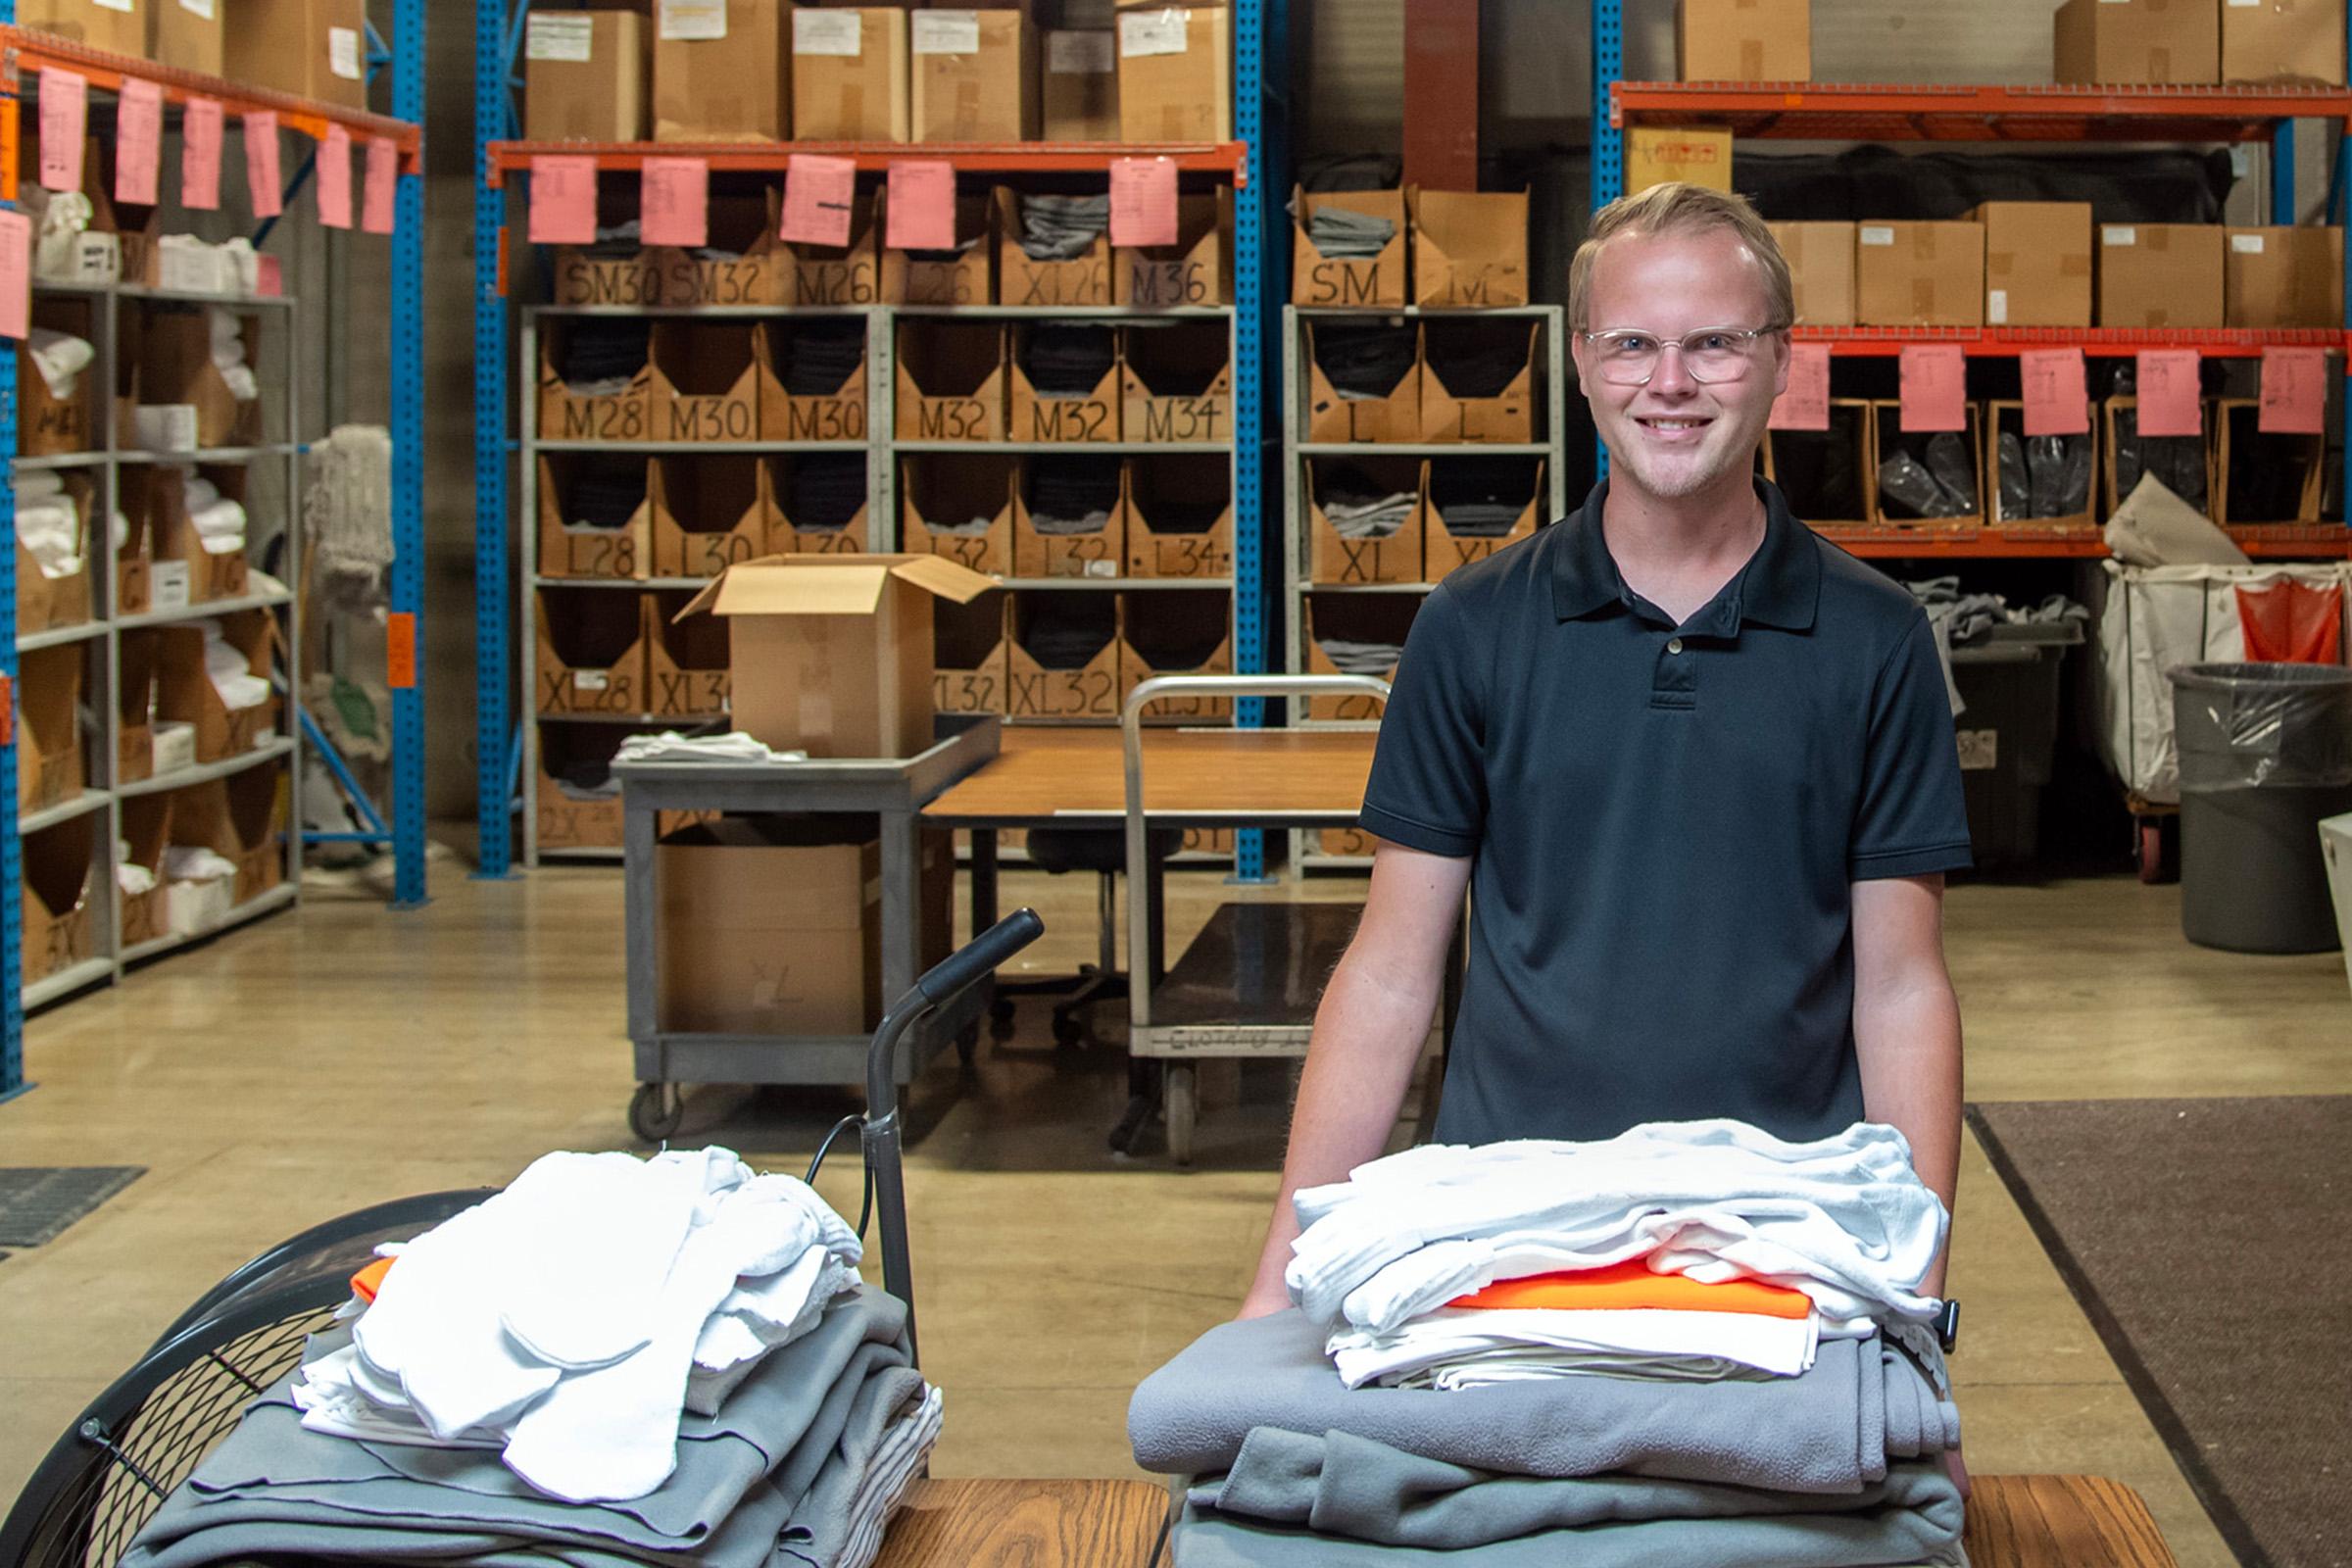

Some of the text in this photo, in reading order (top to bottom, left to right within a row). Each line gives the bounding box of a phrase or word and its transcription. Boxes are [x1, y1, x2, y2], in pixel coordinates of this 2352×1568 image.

[565, 262, 662, 305] SM30
[668, 261, 761, 305] SM32
[796, 261, 872, 305] M26
[1131, 262, 1207, 305] M36
[1311, 262, 1381, 305] SM
[564, 399, 643, 440] M28
[668, 399, 751, 440] M30
[788, 399, 864, 440] M30
[918, 399, 989, 440] M32
[1032, 399, 1109, 441] M32
[1145, 399, 1222, 442] M34
[1346, 401, 1376, 442] L
[1458, 401, 1485, 440] L
[566, 534, 636, 575] L28
[1154, 540, 1215, 576] L34
[1340, 540, 1396, 581] XL
[543, 670, 633, 713] XL28
[1013, 671, 1114, 716] XL32
